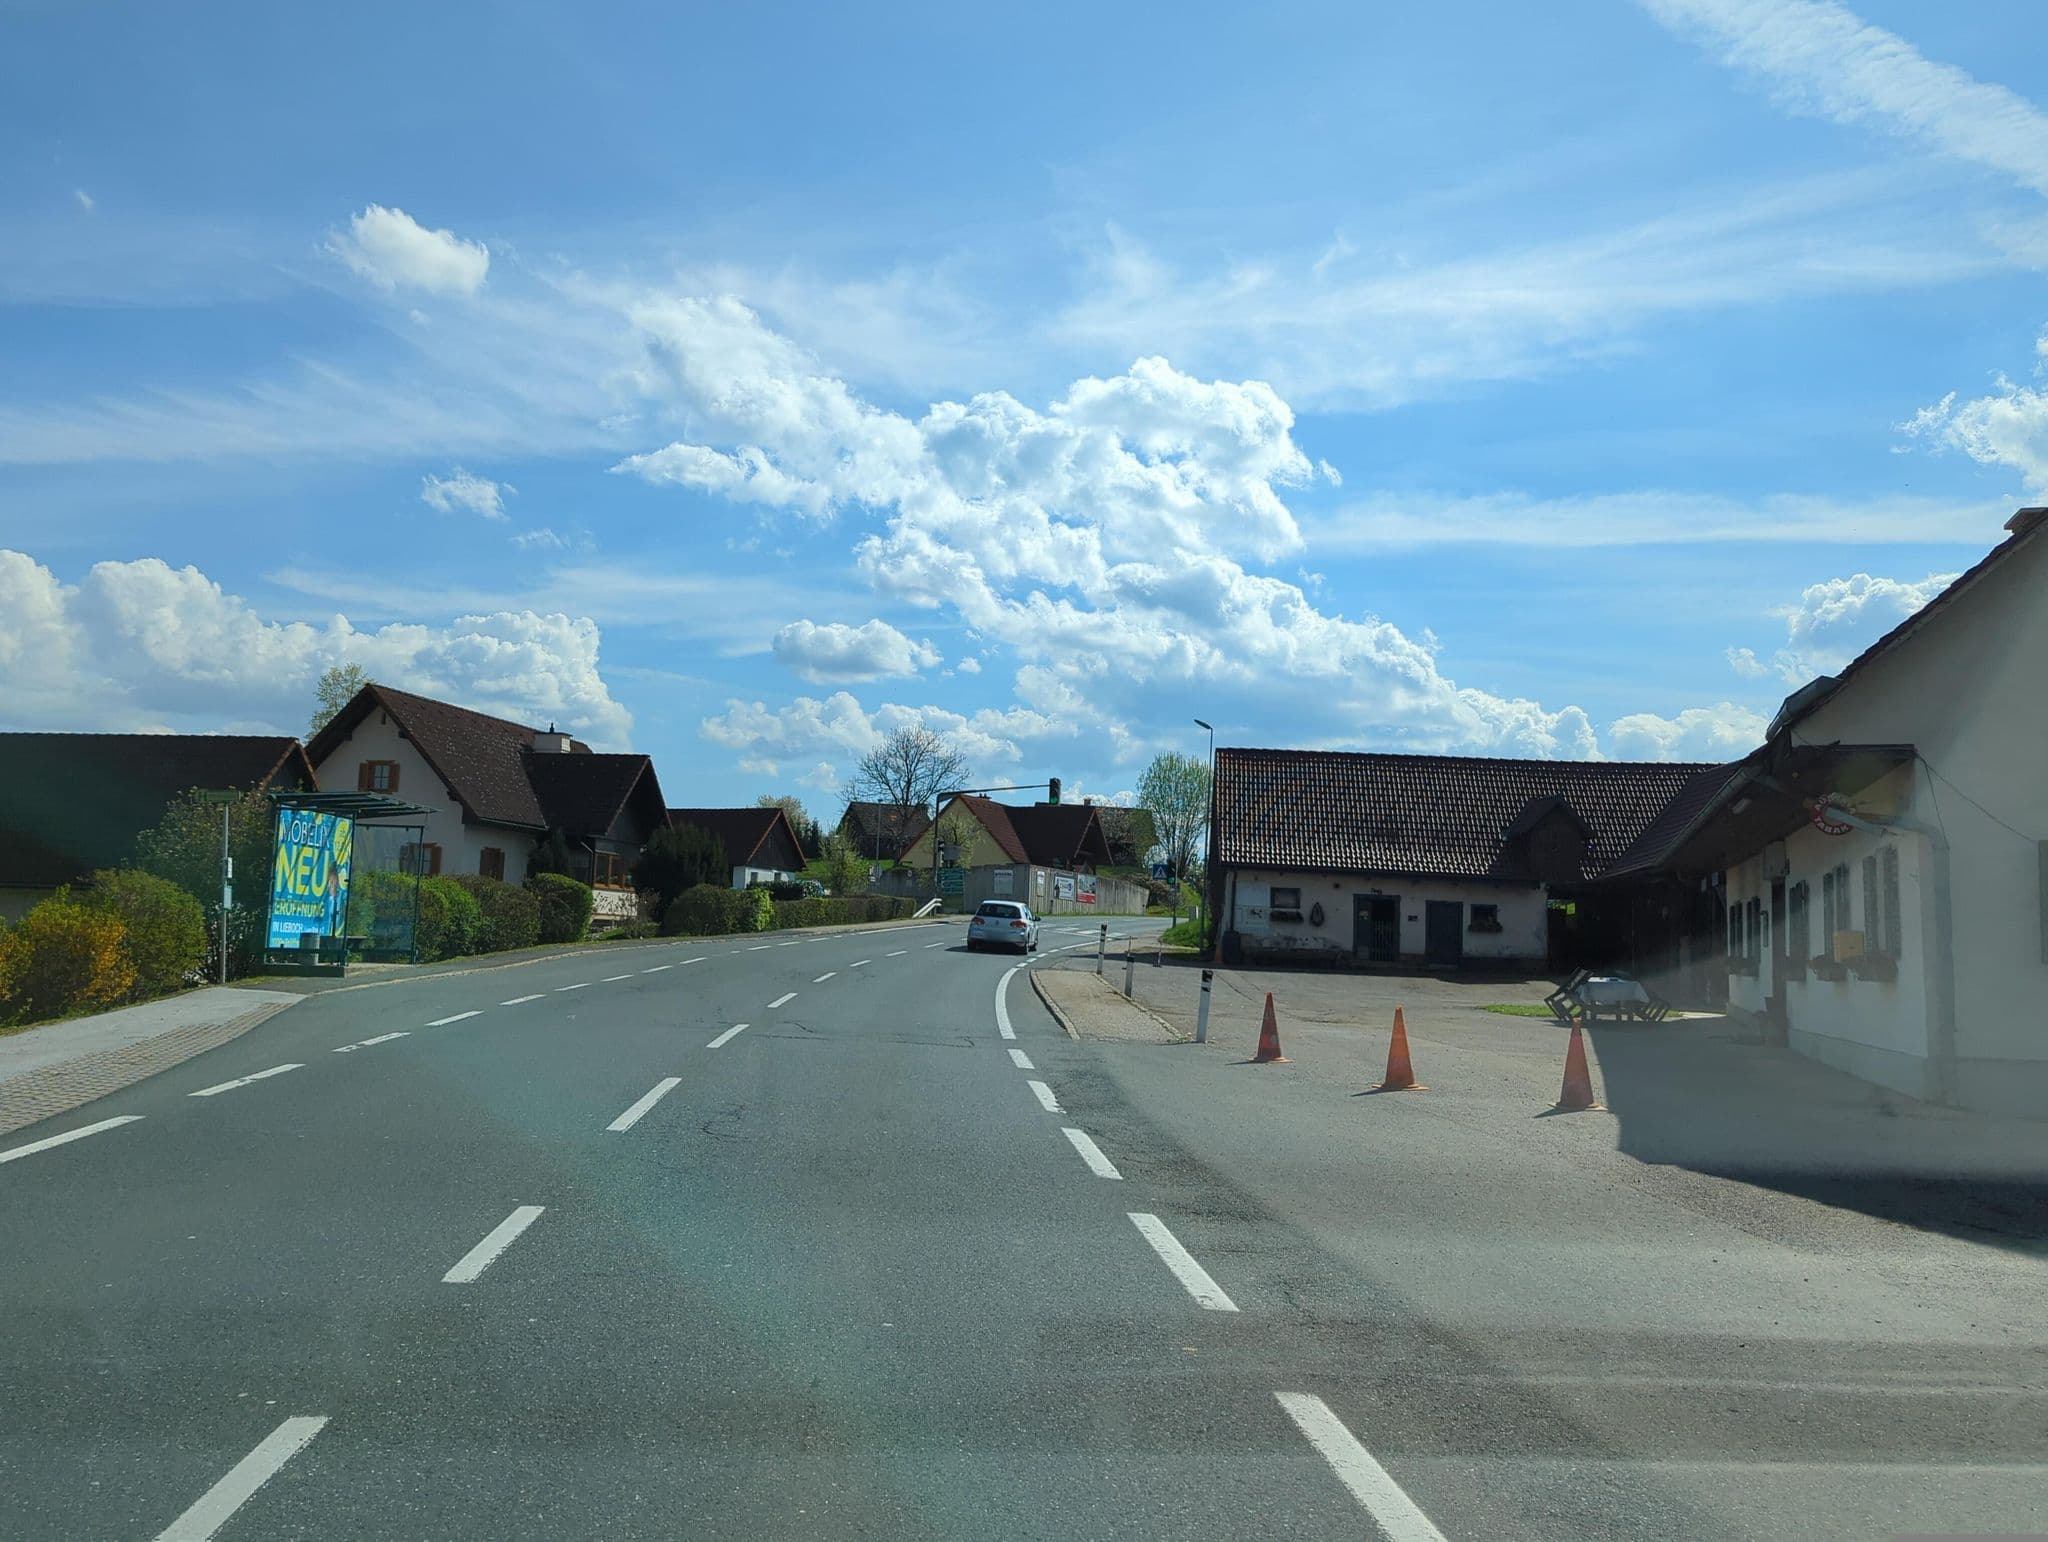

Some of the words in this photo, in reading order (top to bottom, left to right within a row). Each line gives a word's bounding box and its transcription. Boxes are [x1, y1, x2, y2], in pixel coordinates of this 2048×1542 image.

[279, 814, 330, 848] MÖBELIX
[1814, 816, 1849, 833] TABAK
[275, 845, 330, 897] NEU
[274, 896, 325, 917] ERÖFFNUNG
